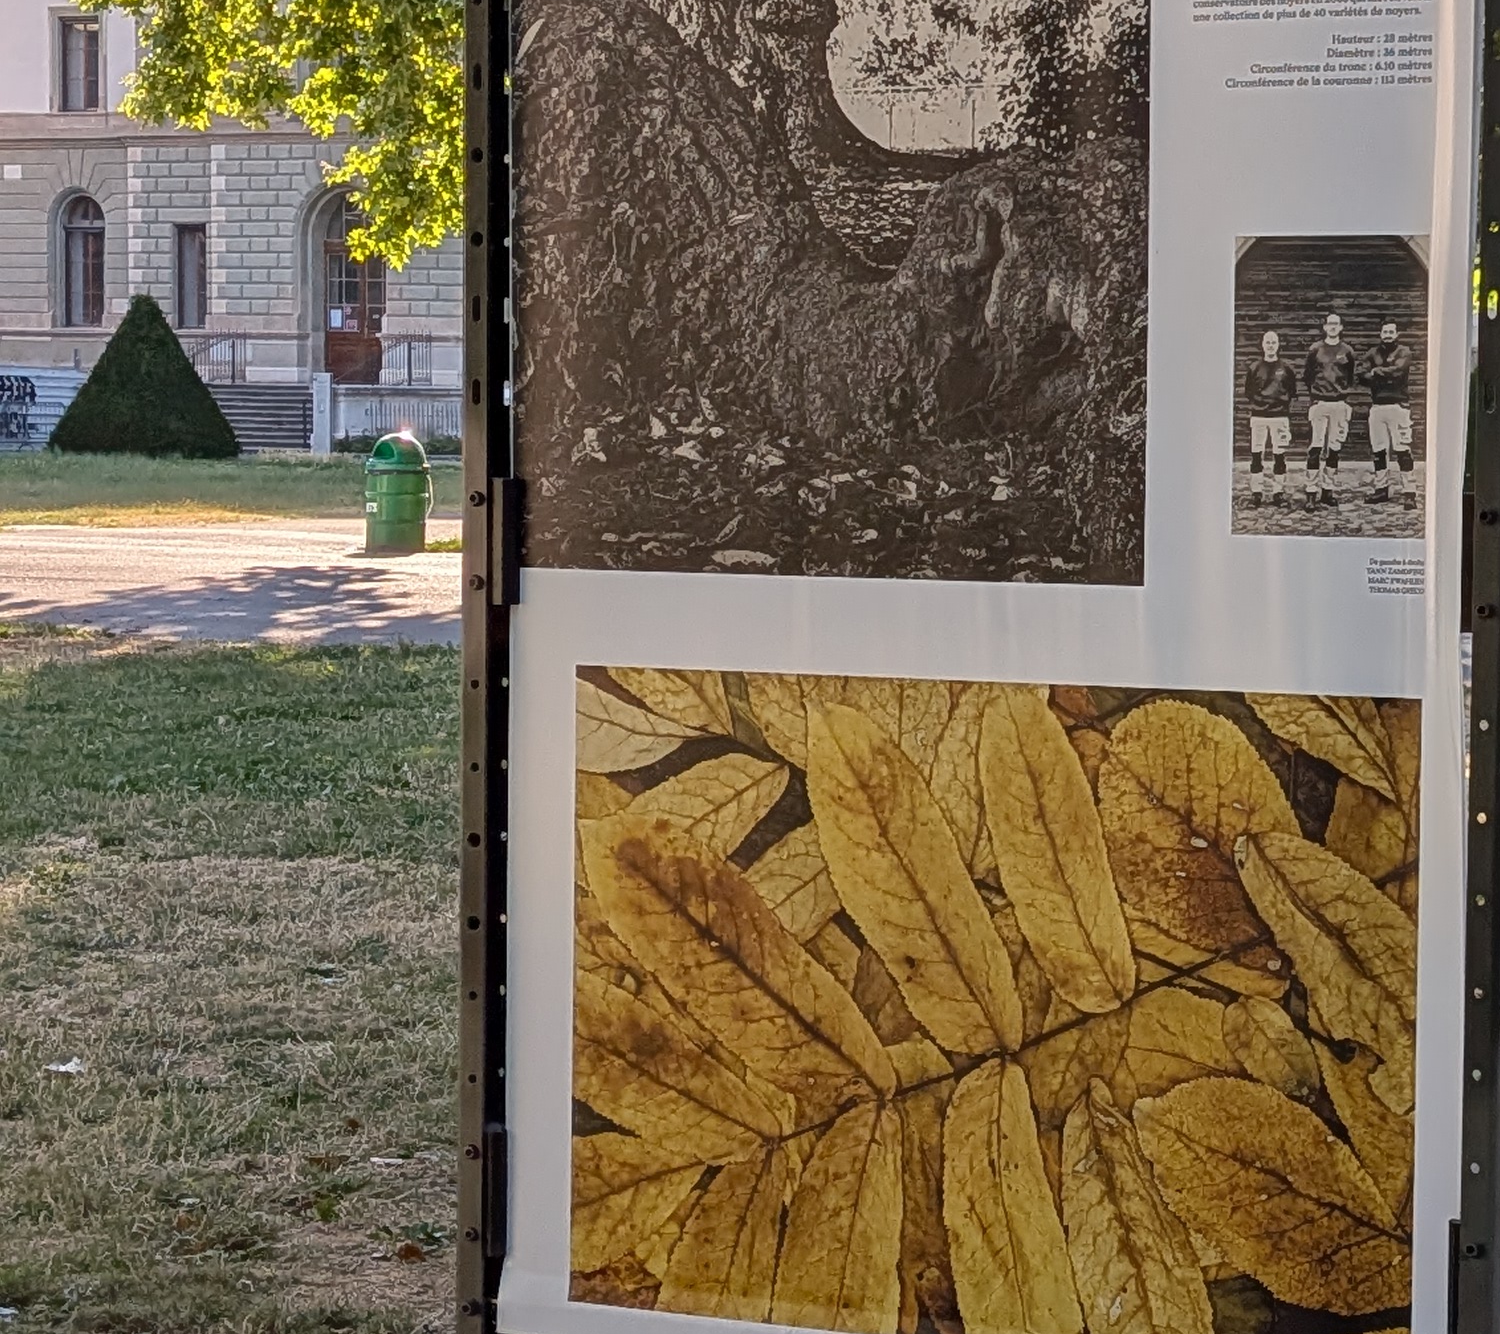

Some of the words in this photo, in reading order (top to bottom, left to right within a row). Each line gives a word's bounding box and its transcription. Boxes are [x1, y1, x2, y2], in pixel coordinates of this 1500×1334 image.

[1193, 12, 1211, 21] une
[1213, 8, 1260, 21] collection
[1262, 8, 1274, 19] de
[1276, 7, 1297, 21] plus
[1299, 7, 1311, 18] de
[1313, 6, 1326, 18] 40
[1328, 5, 1368, 17] variétés
[1371, 5, 1383, 16] de
[1332, 33, 1375, 45] Hauteur
[1398, 30, 1433, 43] mètres
[1327, 46, 1375, 59] Diamètre
[1398, 44, 1433, 56] mètres
[1250, 62, 1321, 75] Circonférence
[1323, 61, 1336, 72] du
[1339, 60, 1367, 72] tronc
[1397, 57, 1433, 70] mètres
[1225, 76, 1294, 89] Circonférence
[1297, 75, 1309, 87] de
[1311, 75, 1321, 86] la
[1323, 76, 1372, 86] couronne
[1397, 71, 1433, 83] mètres
